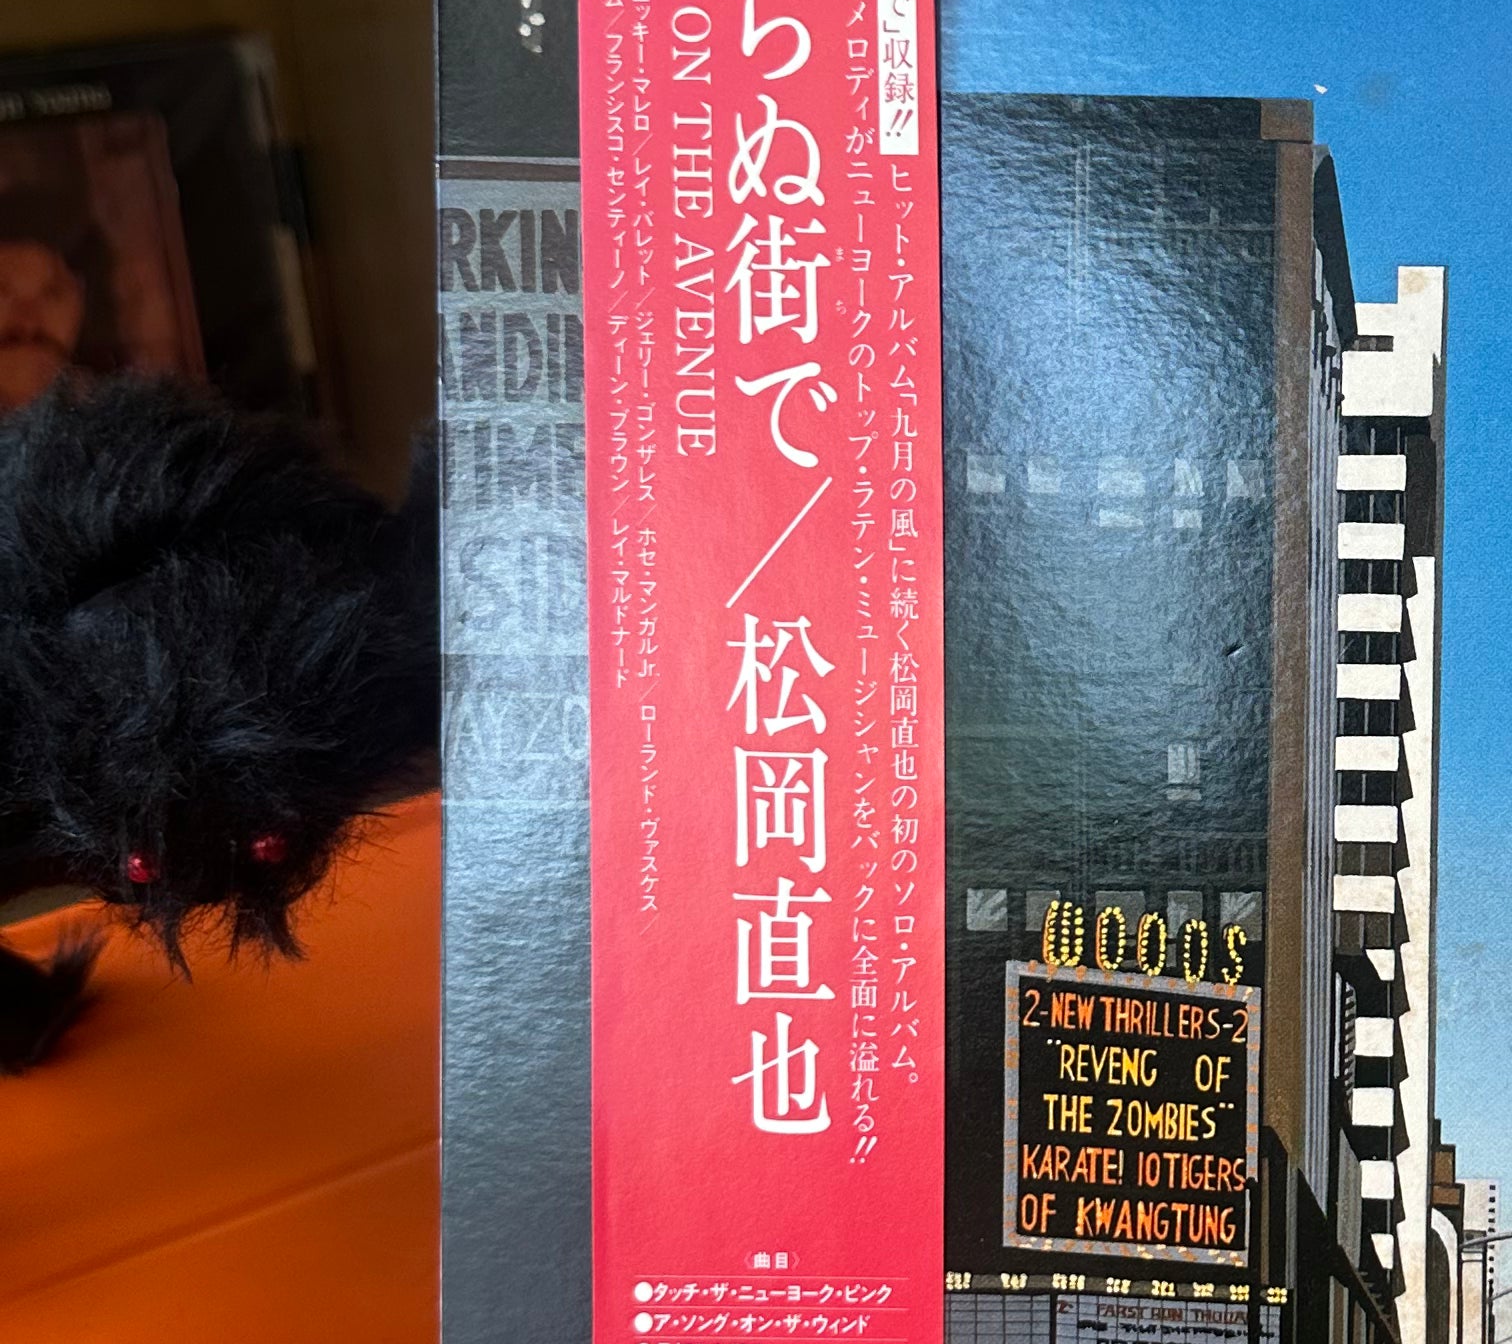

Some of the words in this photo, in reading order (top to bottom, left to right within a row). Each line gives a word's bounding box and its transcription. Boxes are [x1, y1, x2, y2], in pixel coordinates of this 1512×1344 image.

[671, 5, 713, 86] ON
[672, 101, 714, 220] THE
[674, 232, 718, 458] AVENUE
[1042, 899, 1248, 986] WOODS
[1195, 1054, 1232, 1093] OF
[1043, 1092, 1094, 1134] THE
[1021, 1143, 1125, 1186] KARATE!
[1021, 1192, 1057, 1234] OF
[1074, 1195, 1237, 1245] KWANGTUNG
